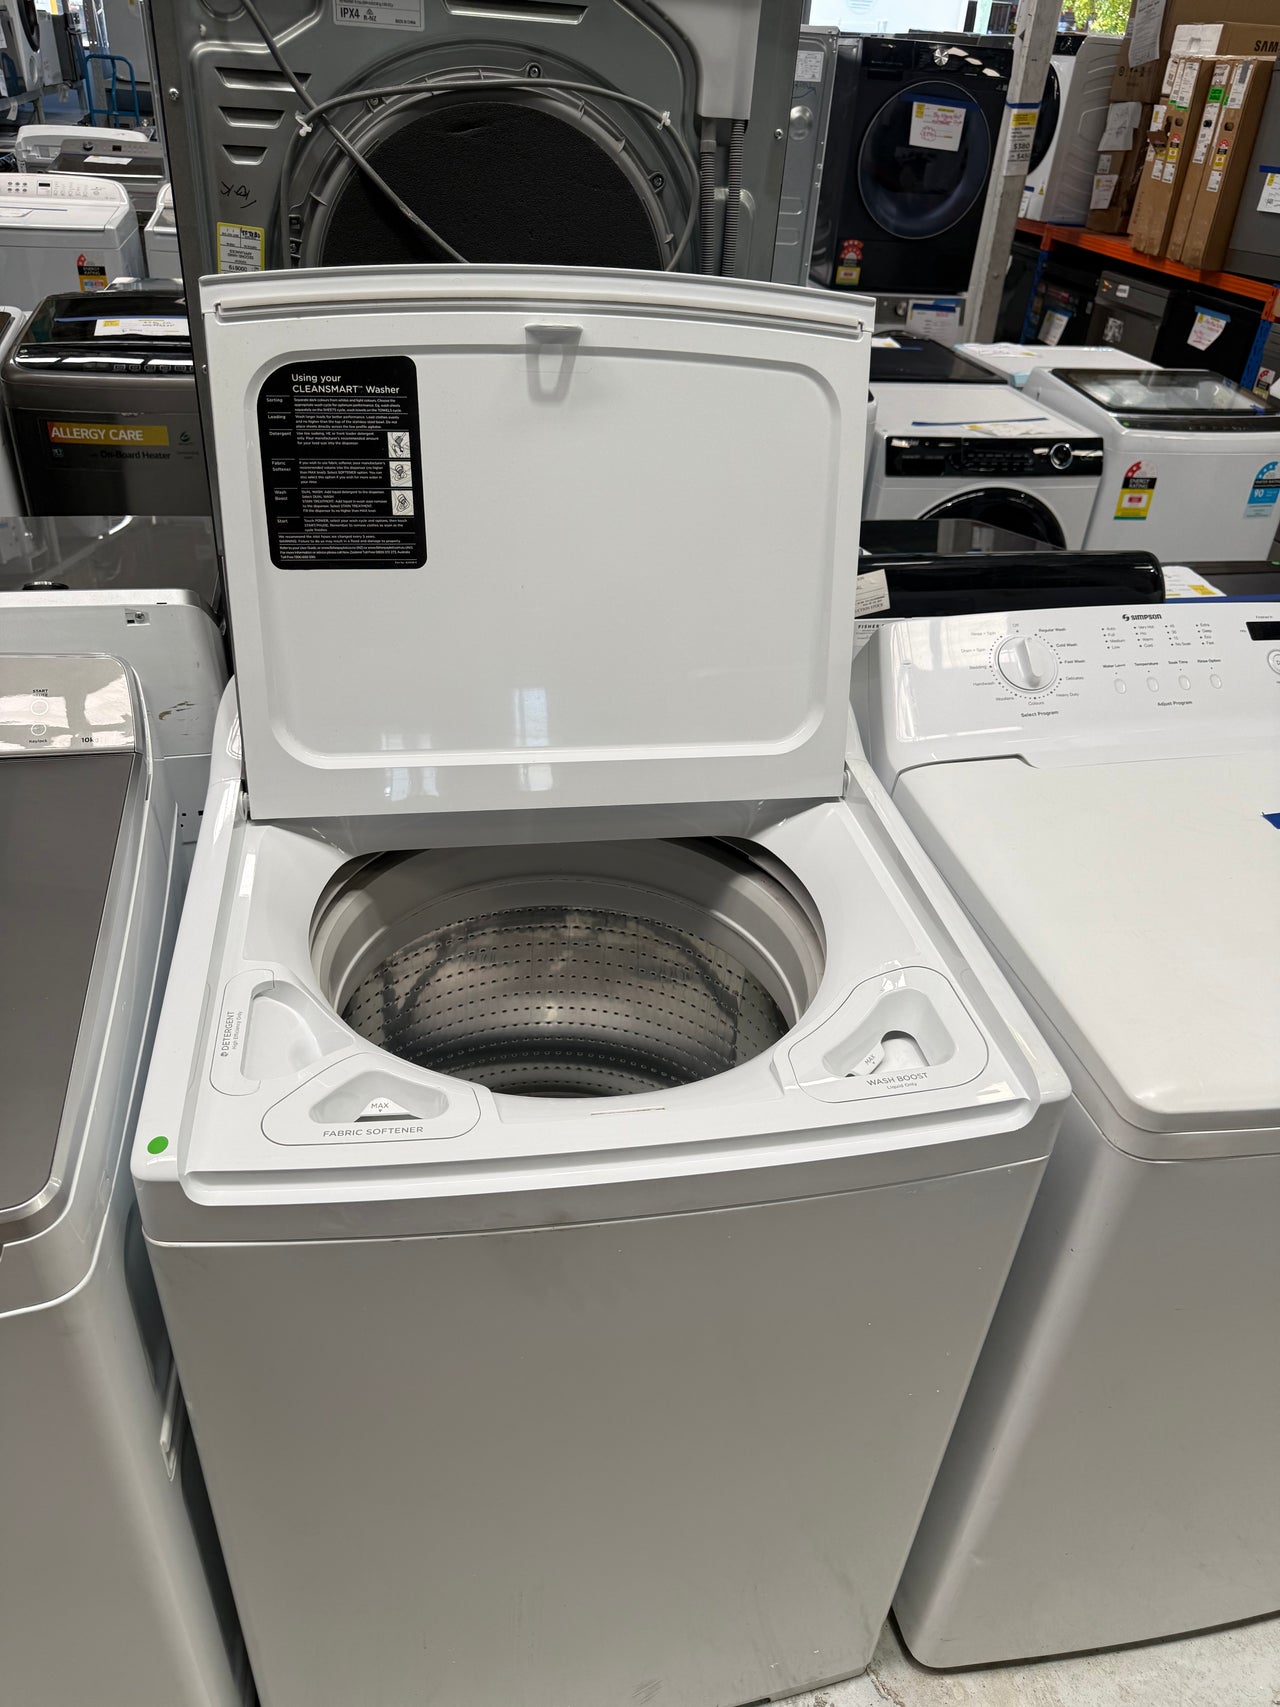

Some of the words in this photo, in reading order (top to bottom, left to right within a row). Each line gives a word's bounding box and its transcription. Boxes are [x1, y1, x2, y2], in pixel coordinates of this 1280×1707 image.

[340, 7, 360, 19] IPX4
[1254, 40, 1280, 52] SAM
[291, 373, 318, 384] Using
[320, 375, 341, 384] your
[365, 385, 400, 394] Washer
[51, 427, 106, 440] ALLERGY
[109, 429, 144, 441] CARE
[100, 450, 140, 459] On-Board
[142, 451, 171, 459] Heater
[221, 1011, 235, 1051] DETERGENT
[233, 1021, 242, 1040] Efficiency
[864, 1053, 876, 1065] MAX
[866, 1077, 896, 1086] WASH
[896, 1072, 928, 1082] BOOST
[323, 1129, 363, 1137] FABRIC
[366, 1126, 424, 1135] SOFTENER
